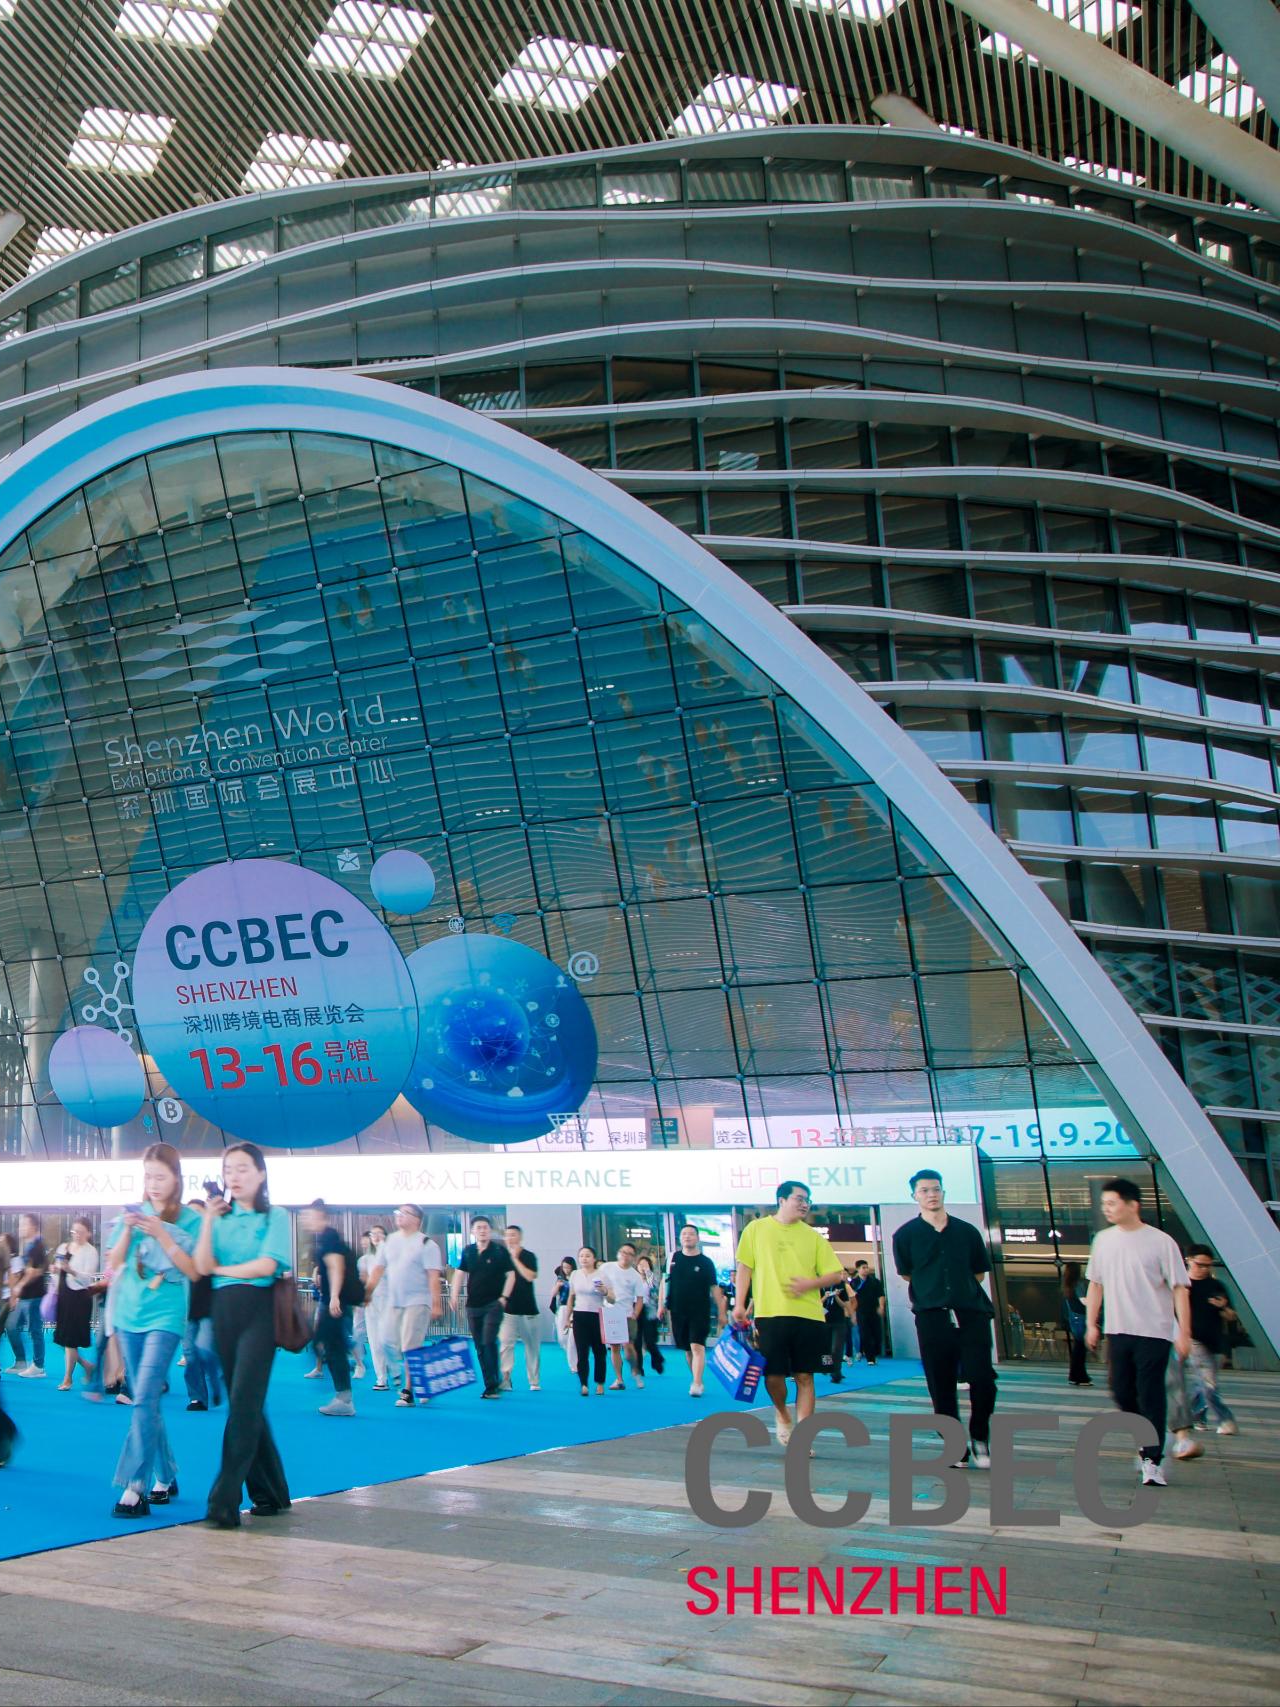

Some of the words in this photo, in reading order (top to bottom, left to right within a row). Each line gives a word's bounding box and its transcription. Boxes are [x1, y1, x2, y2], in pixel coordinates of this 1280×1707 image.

[105, 724, 263, 767] Shenzhen
[272, 695, 385, 739] World
[111, 766, 195, 791] Exhibition
[200, 760, 211, 777] &
[217, 746, 321, 774] Convention
[325, 736, 388, 757] Center
[119, 758, 396, 820] 深圳国际会展中心
[165, 909, 349, 971] CCBEC
[176, 976, 298, 1005] SHENZHEN
[183, 1002, 365, 1035] 深圳跨境电商展览会
[324, 1039, 370, 1063] 号馆
[189, 1042, 323, 1090] 13-16
[328, 1067, 379, 1084] HALL
[544, 1131, 594, 1144] CCBEC
[64, 1174, 134, 1193] 观众入口
[393, 1169, 481, 1191] 观众入口
[504, 1169, 632, 1188] ENTRANCE
[730, 1165, 780, 1188] 出口
[808, 1166, 867, 1186] EXIT
